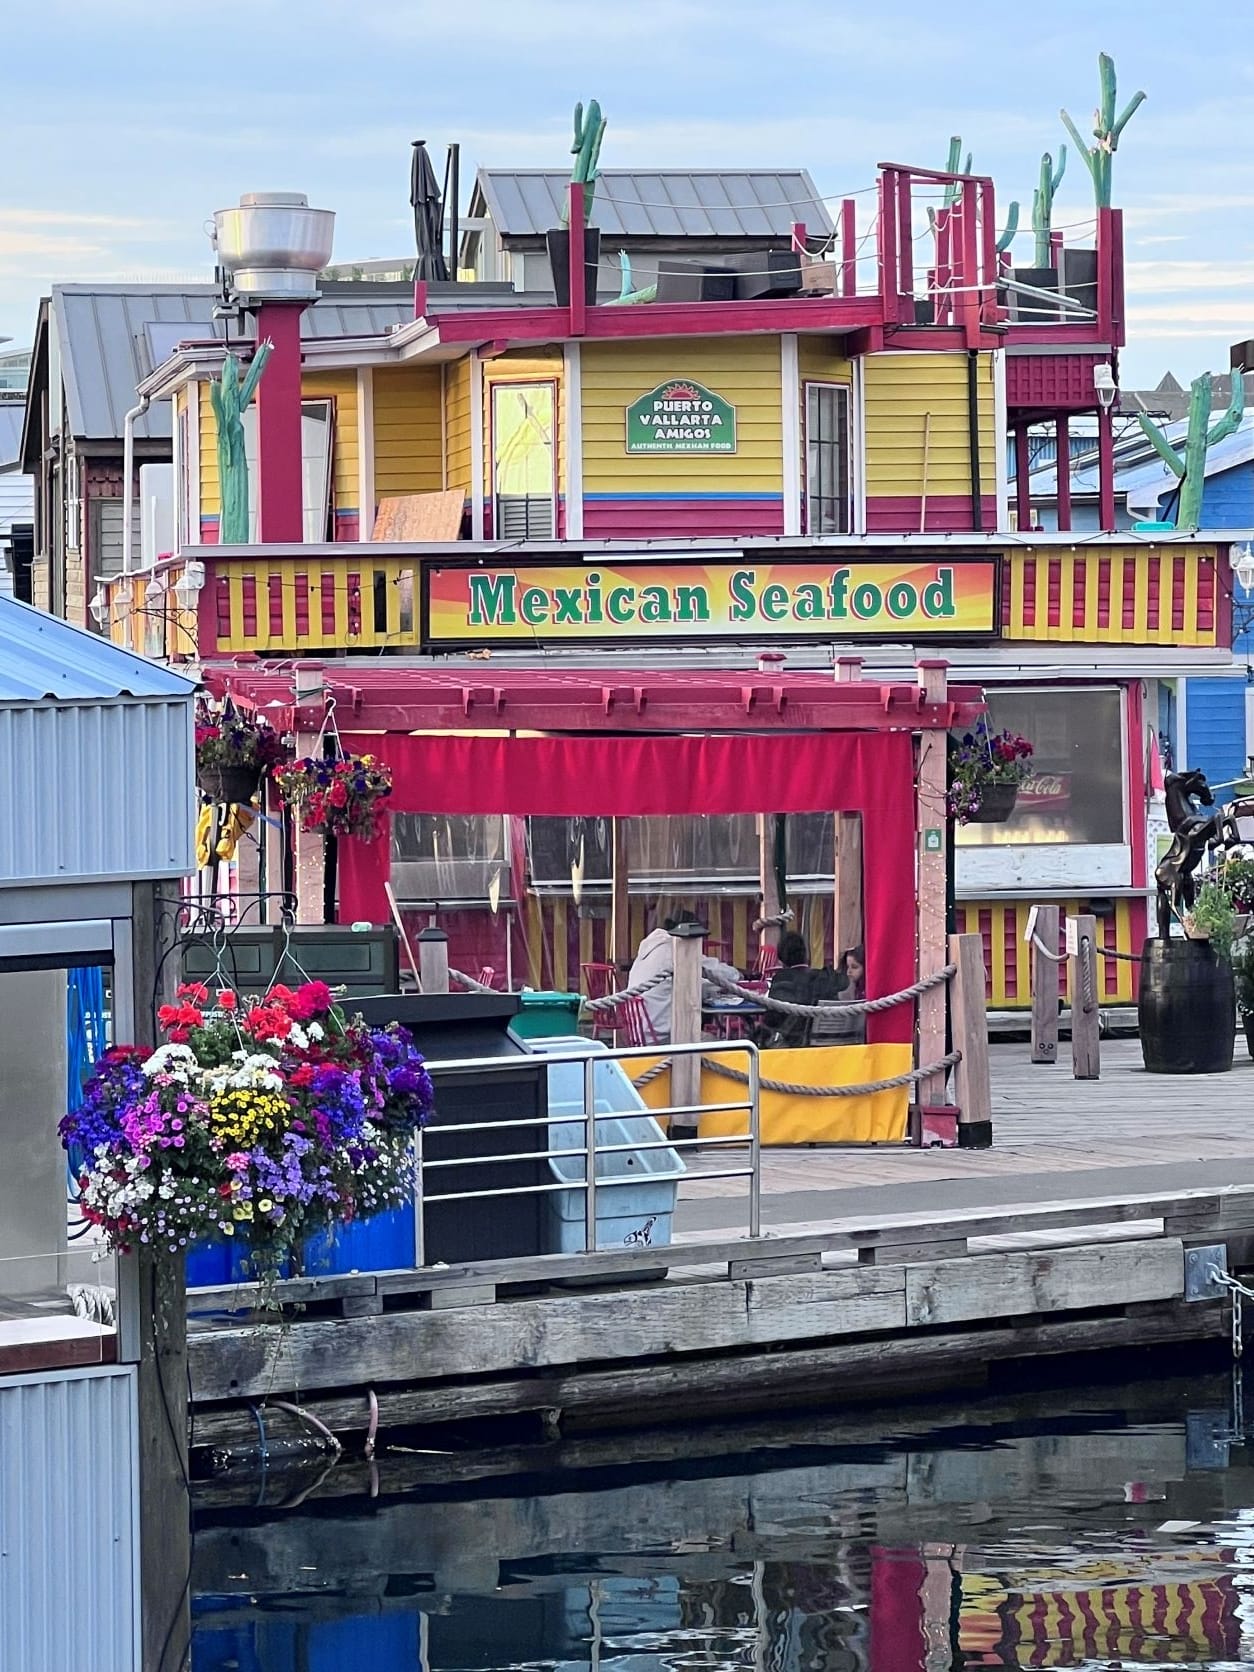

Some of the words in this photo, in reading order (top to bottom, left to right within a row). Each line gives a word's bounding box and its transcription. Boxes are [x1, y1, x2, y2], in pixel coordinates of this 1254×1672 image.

[653, 400, 713, 412] PUERTO
[639, 414, 723, 426] VALLARTA
[654, 428, 711, 439] AMIGOS
[467, 572, 711, 626] Mexican
[729, 567, 956, 622] Seafood
